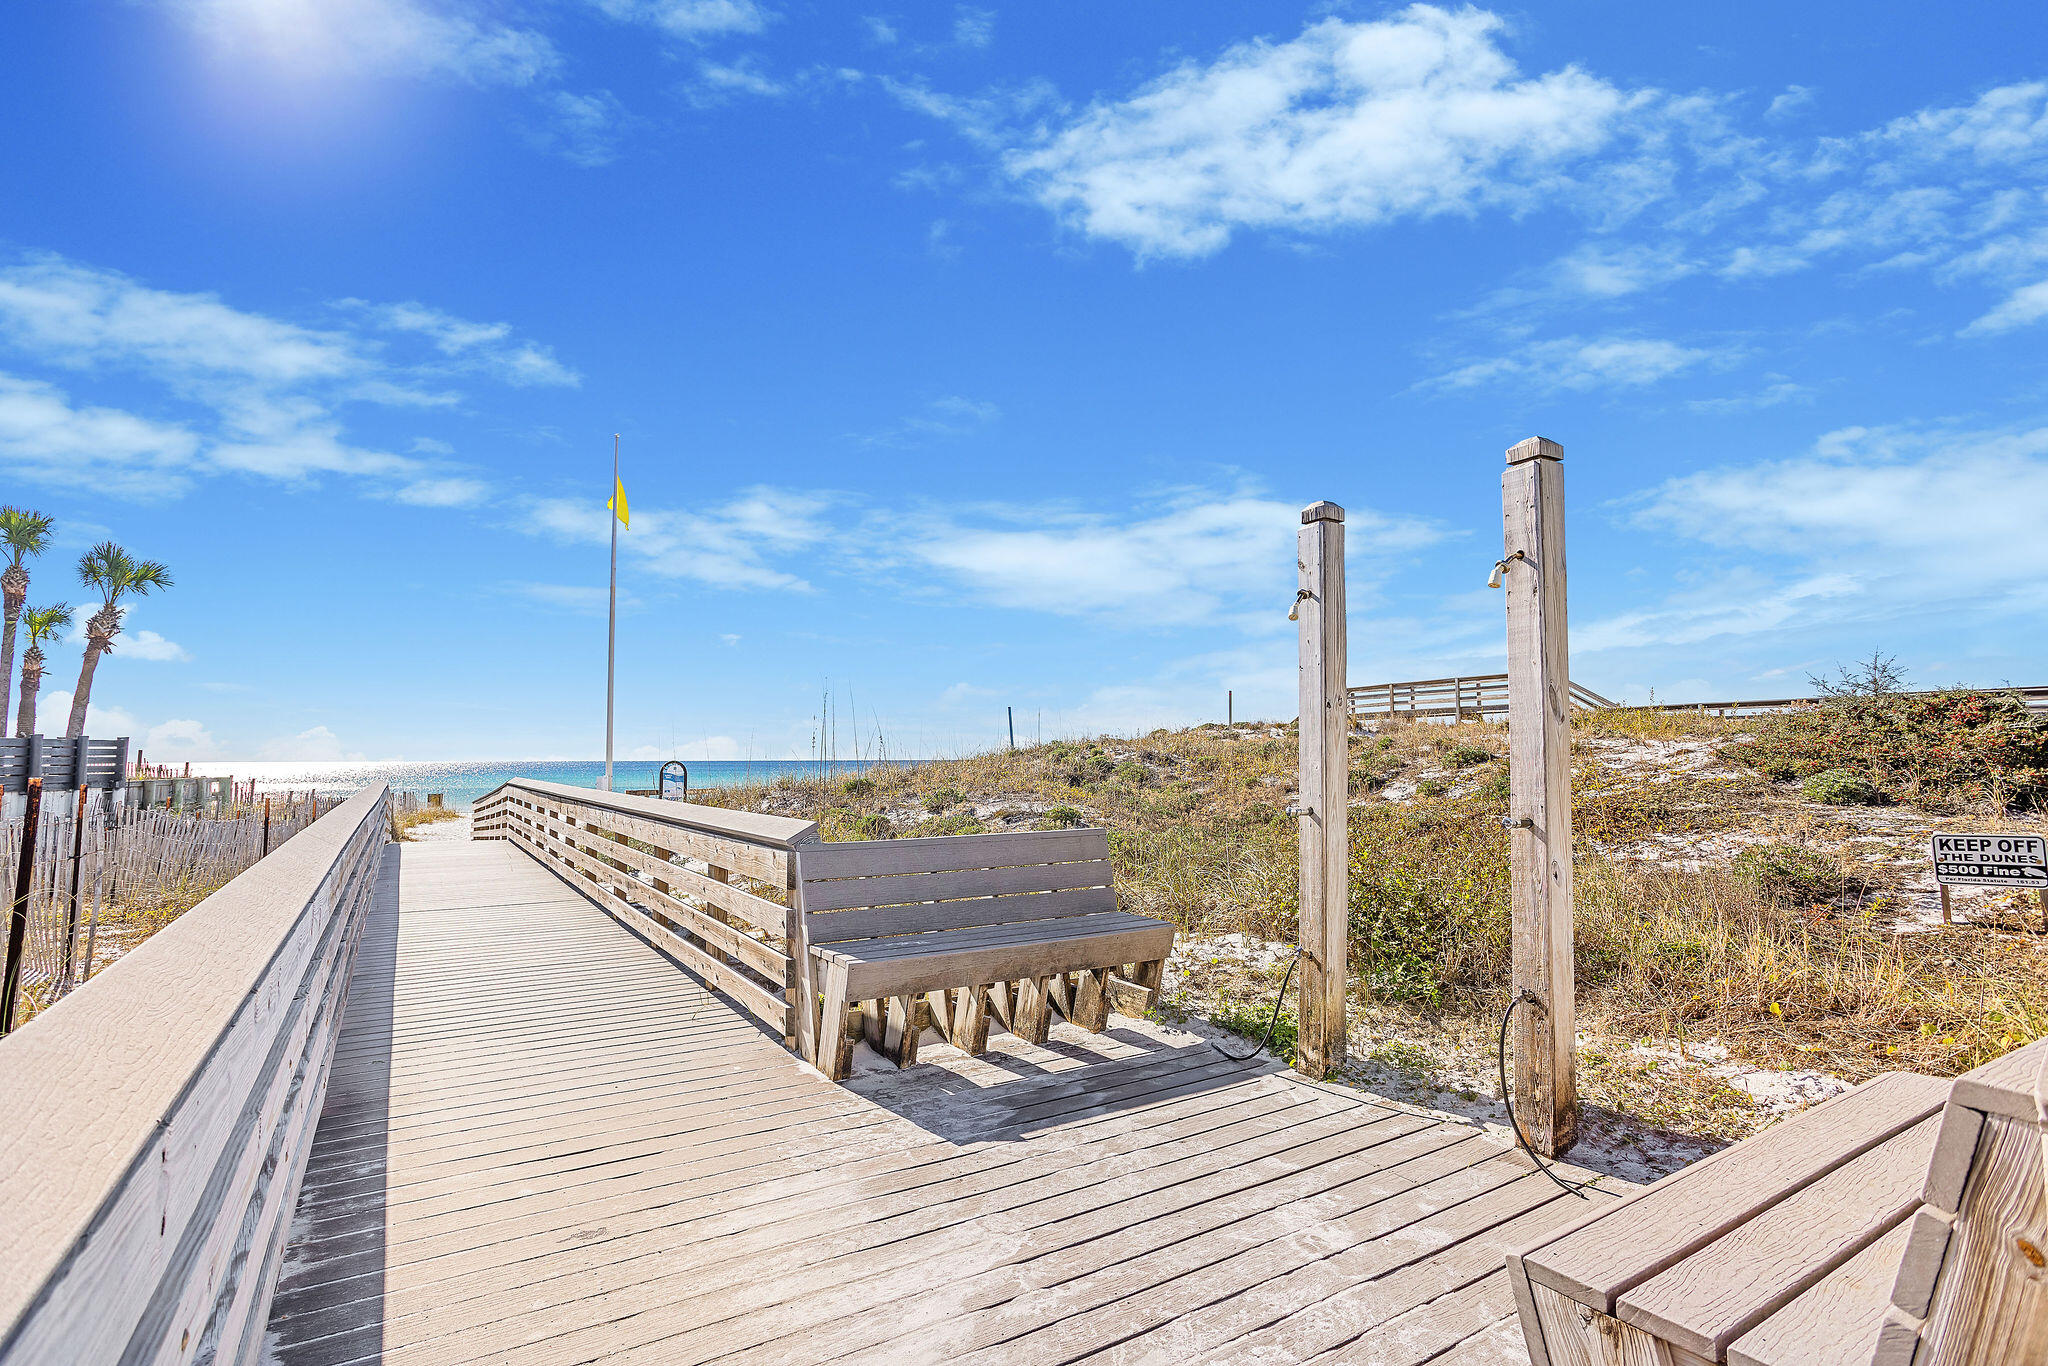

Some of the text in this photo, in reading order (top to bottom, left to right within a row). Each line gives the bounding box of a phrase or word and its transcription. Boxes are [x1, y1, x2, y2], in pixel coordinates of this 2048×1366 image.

[1939, 838, 2037, 853] KEEP OFF
[1940, 853, 2039, 863] THE DUNES
[1938, 865, 2020, 876] $500 Fine
